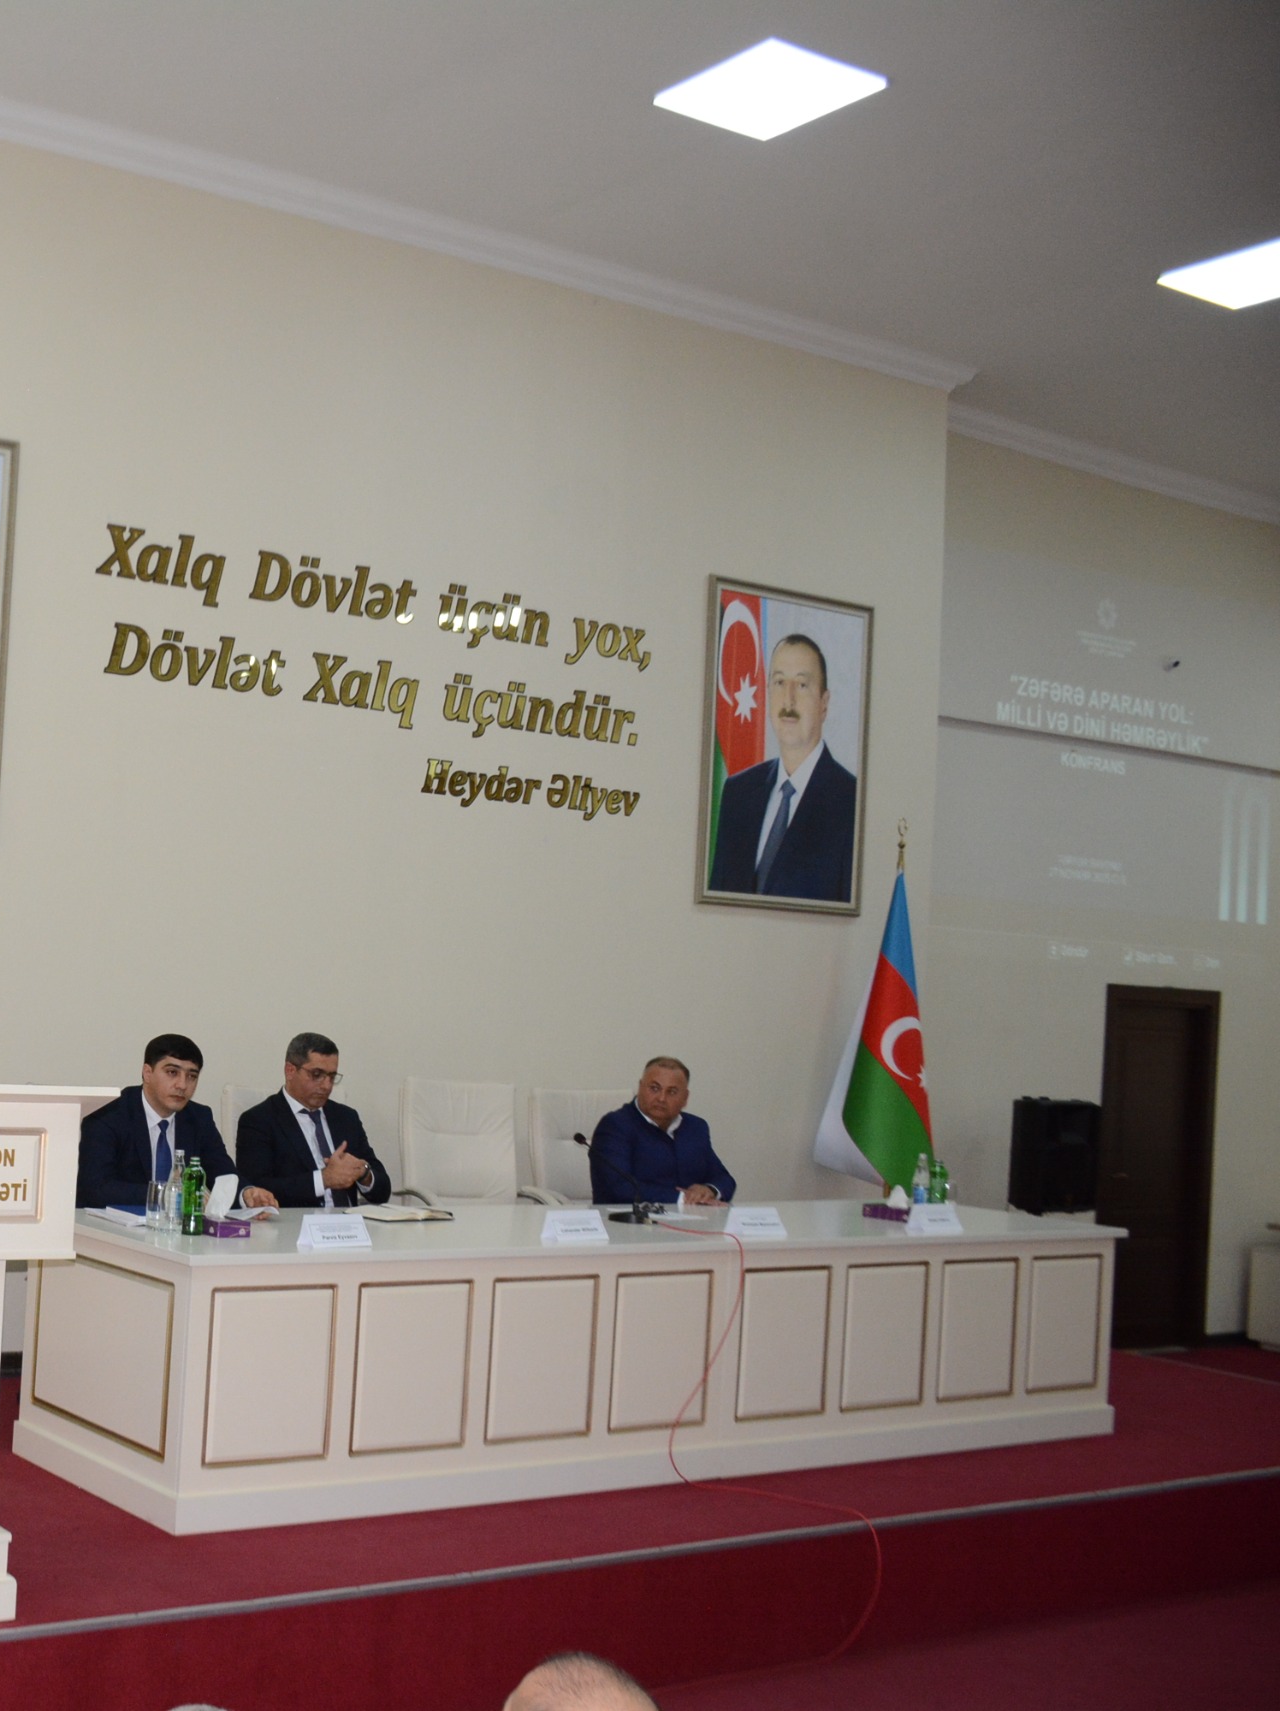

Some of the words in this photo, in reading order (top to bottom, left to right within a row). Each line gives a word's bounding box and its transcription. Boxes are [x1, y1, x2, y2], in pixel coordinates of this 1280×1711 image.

[95, 523, 226, 608] Xalq
[248, 550, 417, 625] Dövlət
[437, 583, 549, 648] üçün
[564, 617, 652, 671] yox,
[103, 622, 286, 697] Dövlət
[302, 652, 420, 730] Xalq
[442, 673, 638, 747] üçündür.
[1087, 689, 1154, 718] APARAN
[996, 700, 1042, 728] MİLLİ
[1046, 710, 1069, 732] VƏ
[1072, 712, 1106, 739] DİNİ
[1060, 752, 1126, 775] KONFRANS
[420, 758, 541, 808] Heydər
[546, 773, 641, 821] Əliyev
